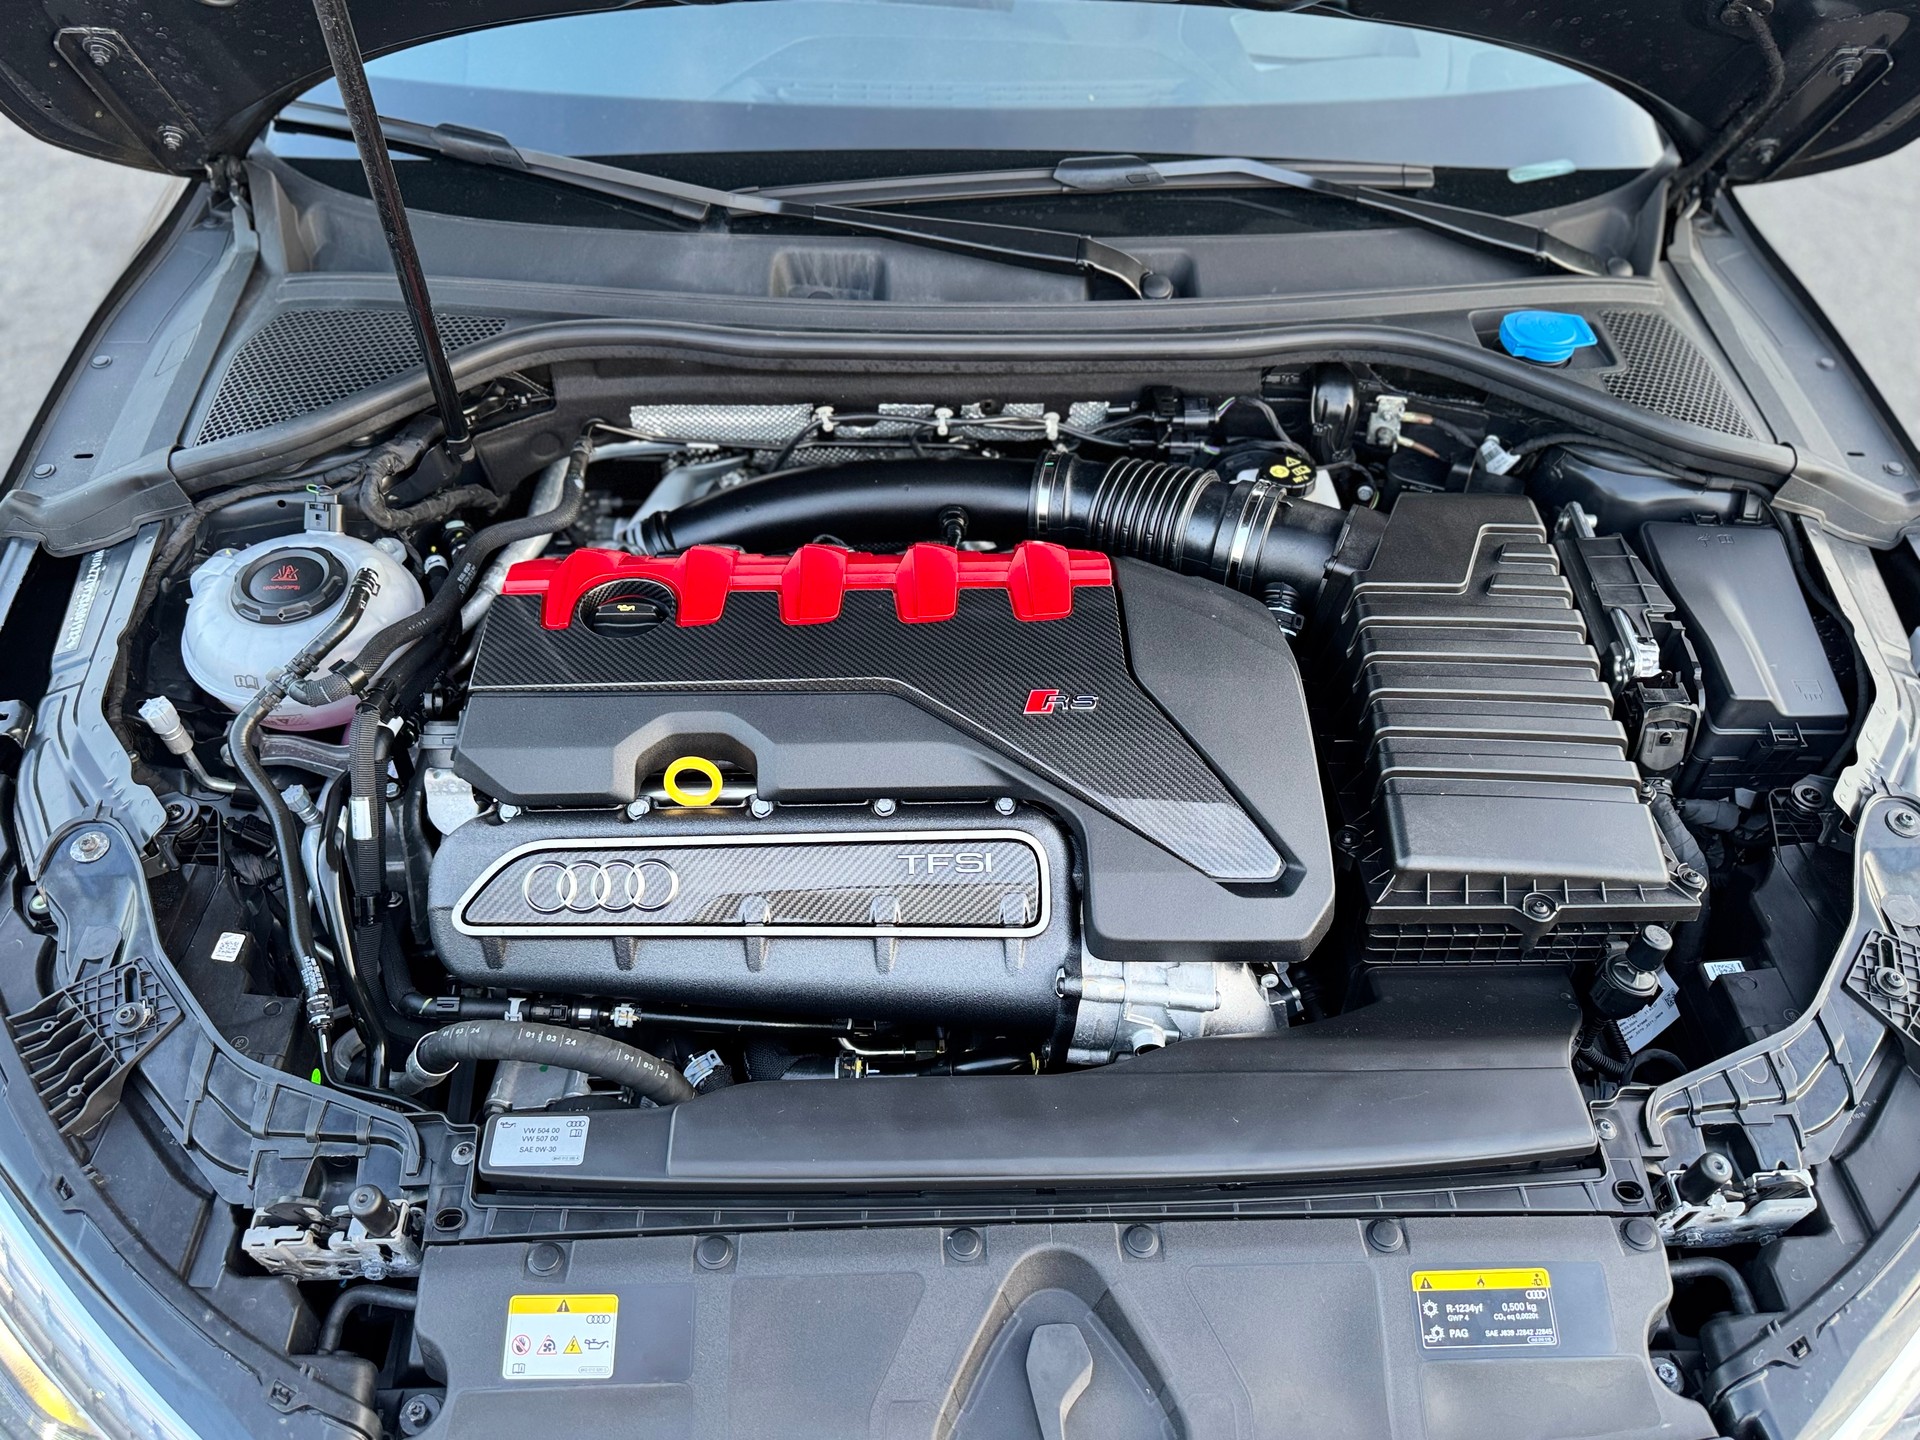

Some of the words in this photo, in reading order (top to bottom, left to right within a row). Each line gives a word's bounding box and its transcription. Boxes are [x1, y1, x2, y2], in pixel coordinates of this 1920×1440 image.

[1041, 694, 1099, 710] RS
[897, 852, 992, 875] TFSI
[525, 1031, 535, 1039] 01
[546, 1034, 557, 1042] 03
[565, 1038, 578, 1047] 24
[624, 1053, 634, 1062] 01
[643, 1061, 654, 1071] 03
[658, 1068, 669, 1079] 24
[1446, 1303, 1483, 1315] R-1234yf
[1501, 1302, 1525, 1312] 0,500
[1526, 1302, 1537, 1313] kg
[1447, 1314, 1463, 1322] GWP
[1463, 1313, 1470, 1322] 4
[1449, 1328, 1469, 1338] PAG
